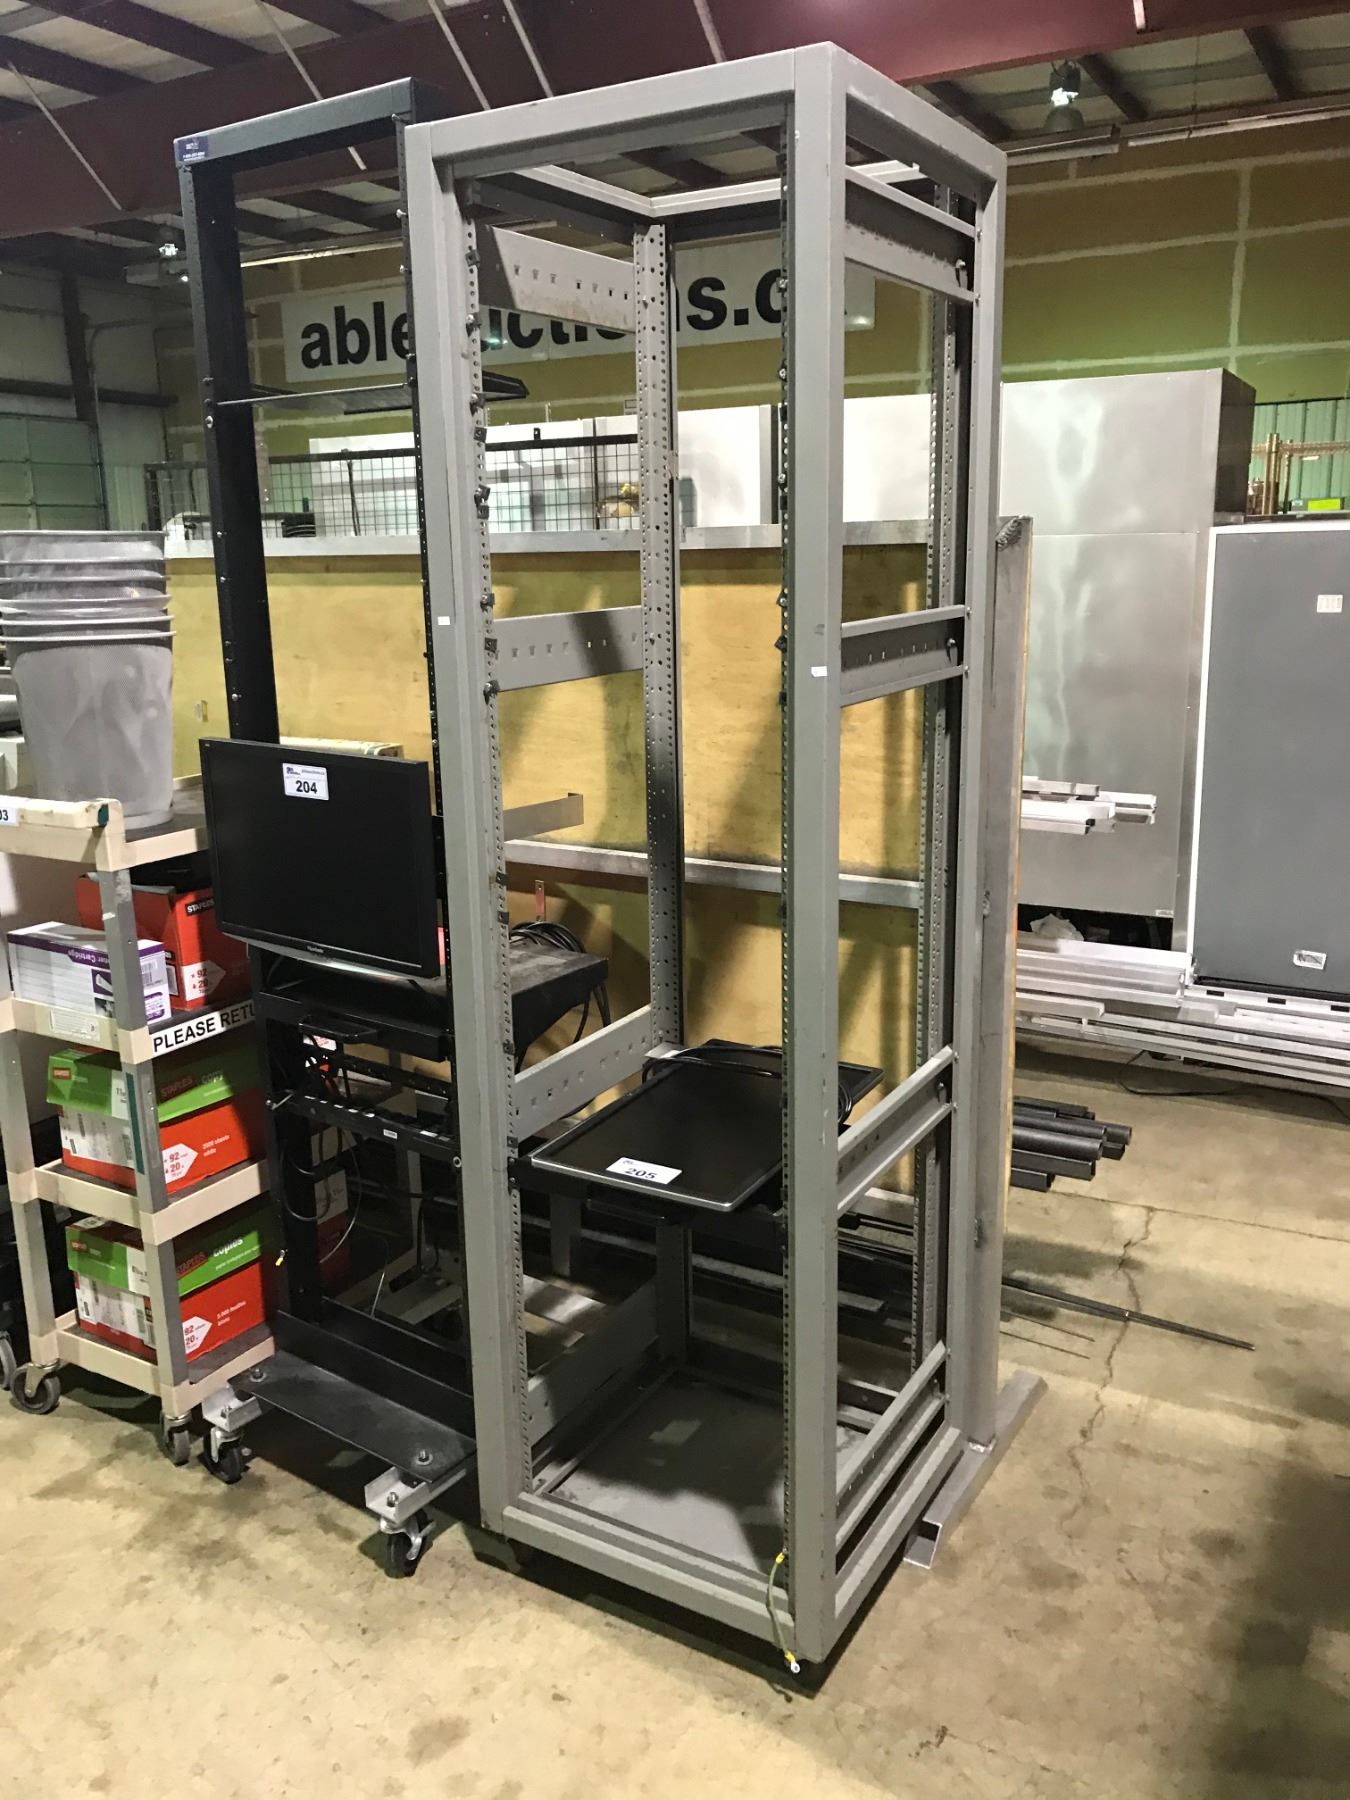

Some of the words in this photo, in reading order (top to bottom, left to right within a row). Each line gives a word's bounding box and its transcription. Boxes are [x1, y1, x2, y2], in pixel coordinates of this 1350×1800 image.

[295, 780, 318, 794] 204
[197, 968, 208, 979] 92
[198, 978, 209, 990] 20
[153, 1017, 216, 1052] PLEASE
[169, 1152, 180, 1163] 92
[170, 1162, 181, 1173] 20
[625, 1168, 658, 1179] 205
[184, 1325, 194, 1336] 92
[186, 1335, 196, 1346] 20
